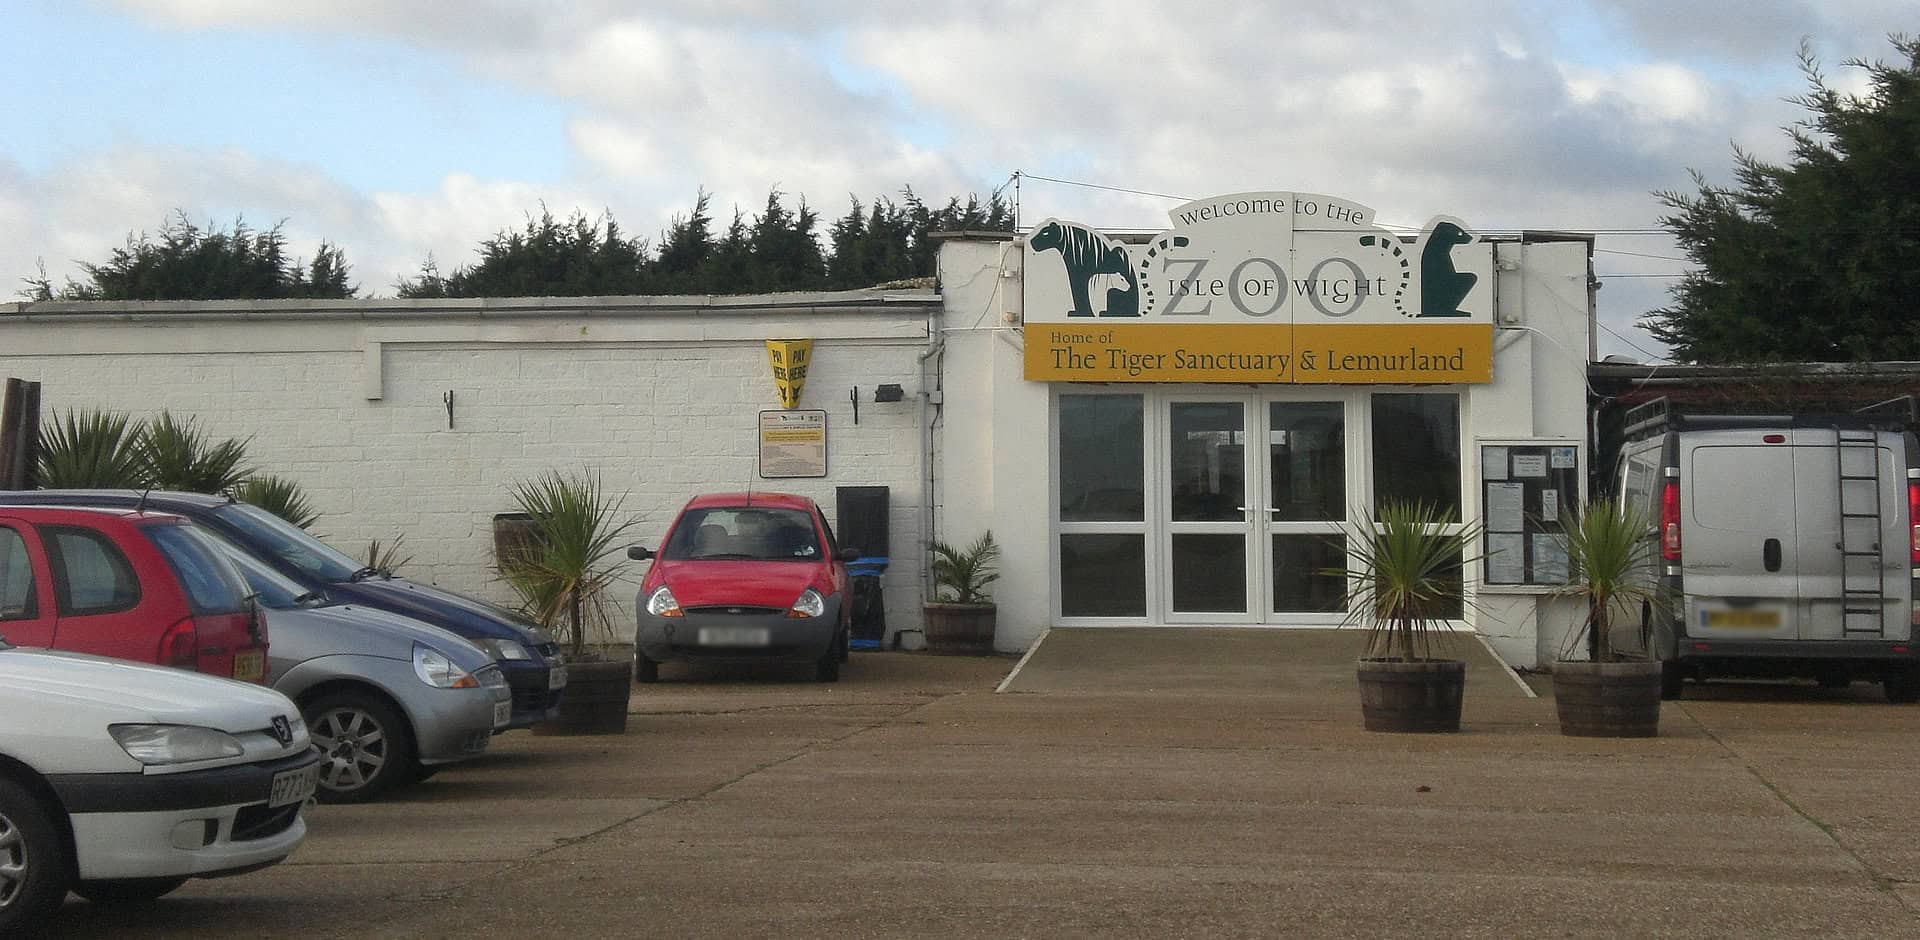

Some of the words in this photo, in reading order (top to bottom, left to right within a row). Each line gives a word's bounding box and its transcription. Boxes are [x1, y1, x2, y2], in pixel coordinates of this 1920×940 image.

[1294, 198, 1318, 216] to
[1160, 256, 1368, 318] ZOO
[1244, 279, 1275, 297] OF
[1051, 331, 1093, 344] Home
[1099, 330, 1115, 344] of
[792, 348, 807, 364] PAY
[1050, 346, 1097, 370] The
[1105, 348, 1167, 377] Tiger
[1174, 349, 1291, 377] Sanctuary
[1300, 350, 1318, 371] &
[1327, 347, 1465, 371] Lemurland
